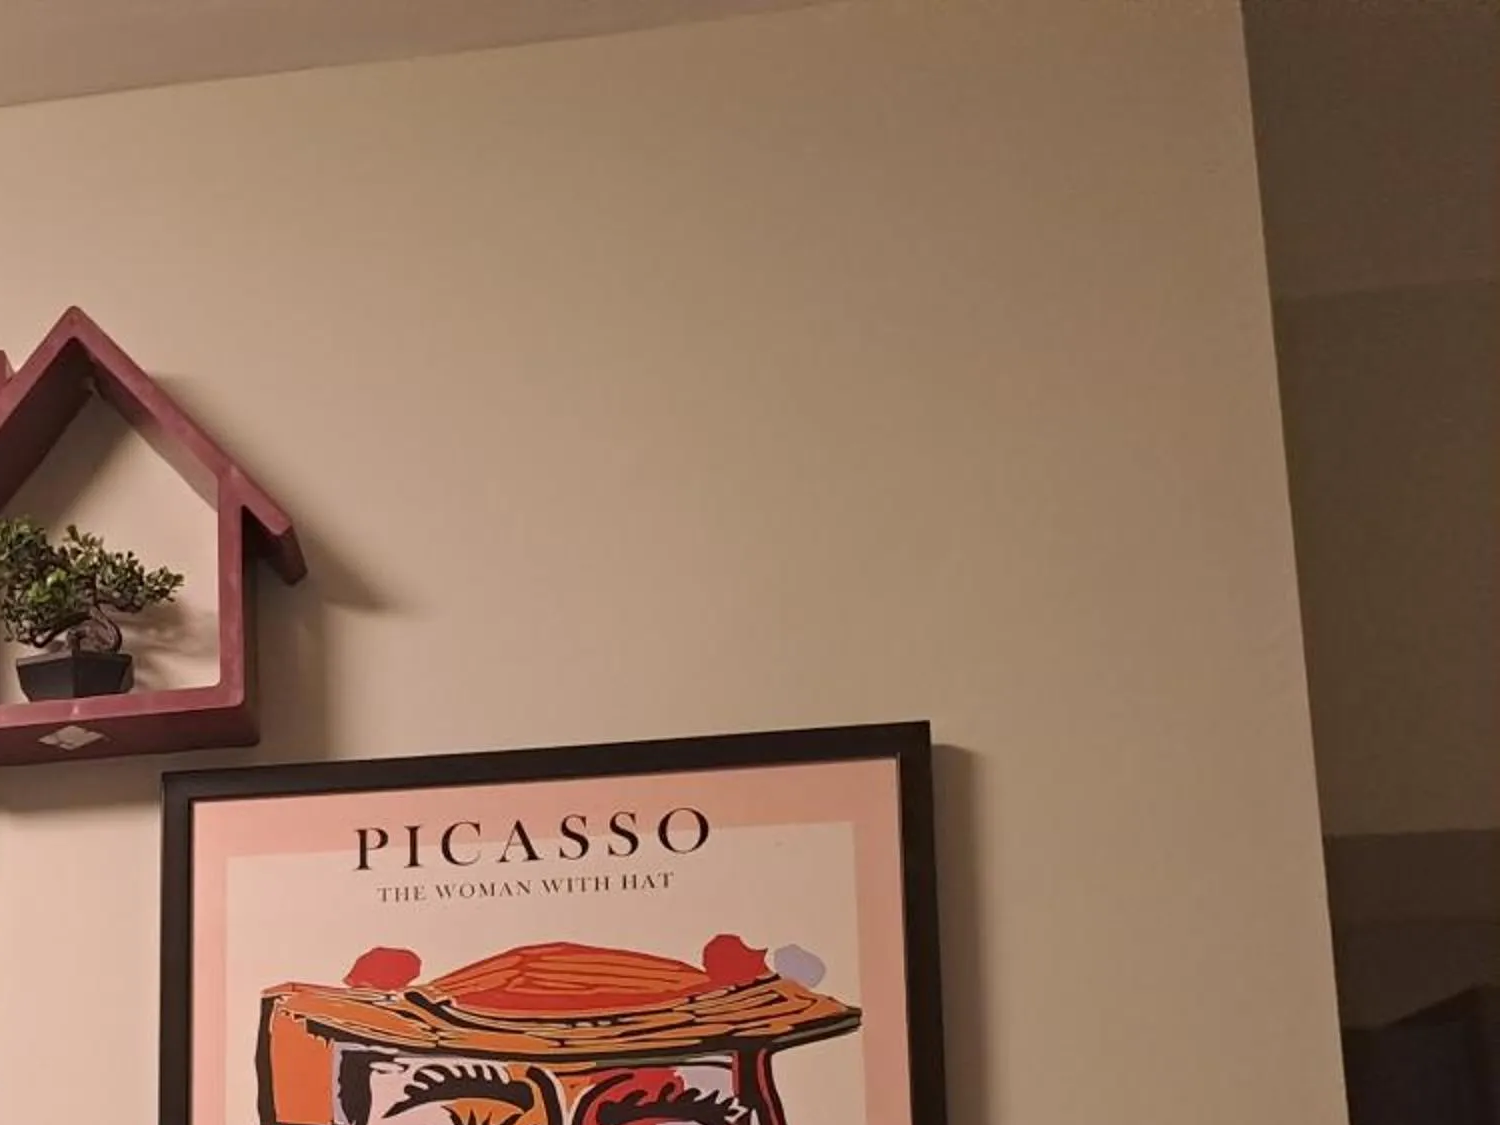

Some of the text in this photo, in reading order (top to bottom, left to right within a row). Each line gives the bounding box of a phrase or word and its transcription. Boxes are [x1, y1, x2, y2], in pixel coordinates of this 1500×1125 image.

[354, 806, 711, 871] PICASSO
[377, 871, 674, 903] THE WOMAN WITH HAT
